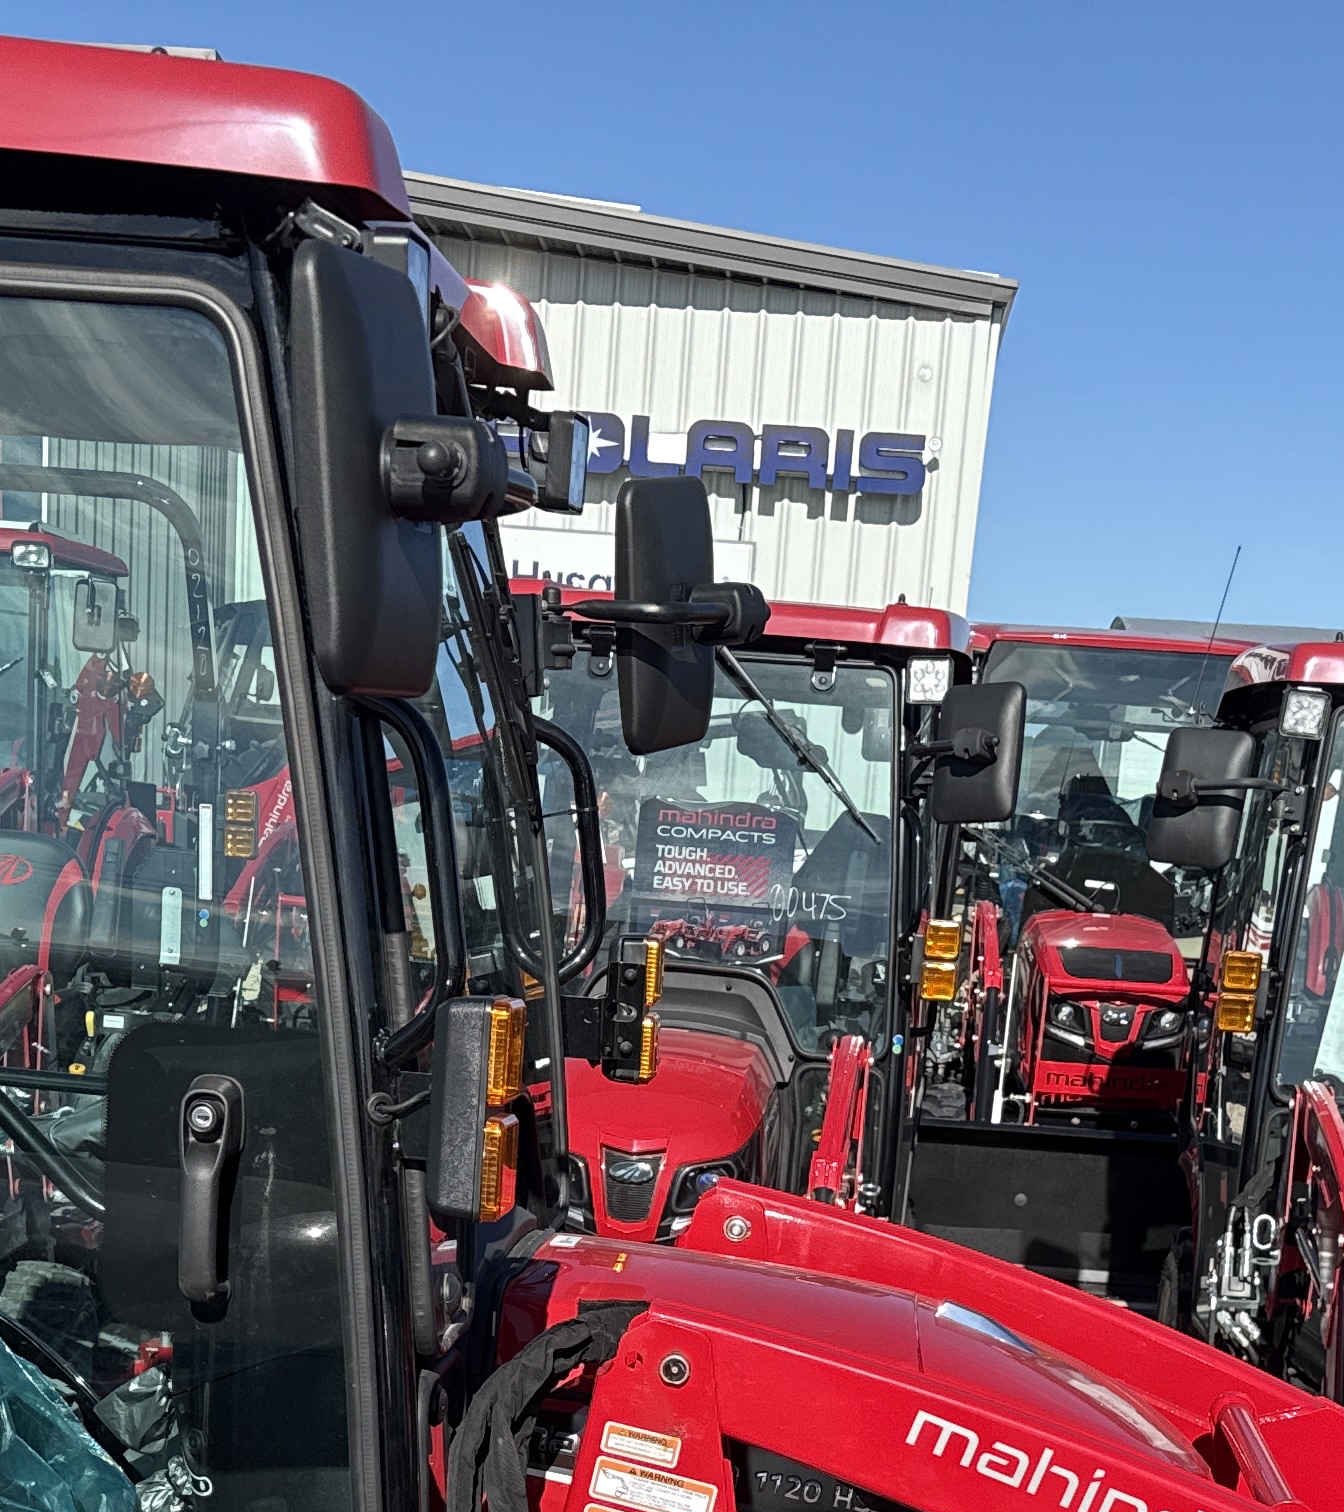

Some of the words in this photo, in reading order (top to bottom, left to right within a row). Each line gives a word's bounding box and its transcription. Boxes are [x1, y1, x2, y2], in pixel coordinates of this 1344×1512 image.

[501, 411, 927, 496] OLARIS
[658, 808, 778, 830] mahindra
[656, 825, 777, 845] COMPACTS
[656, 844, 711, 862] TOUGH.
[653, 861, 739, 879] ADVANCED.
[653, 875, 692, 891] EASY
[694, 878, 714, 893] TO
[716, 881, 751, 896] USE.
[639, 1468, 685, 1488] WARNING
